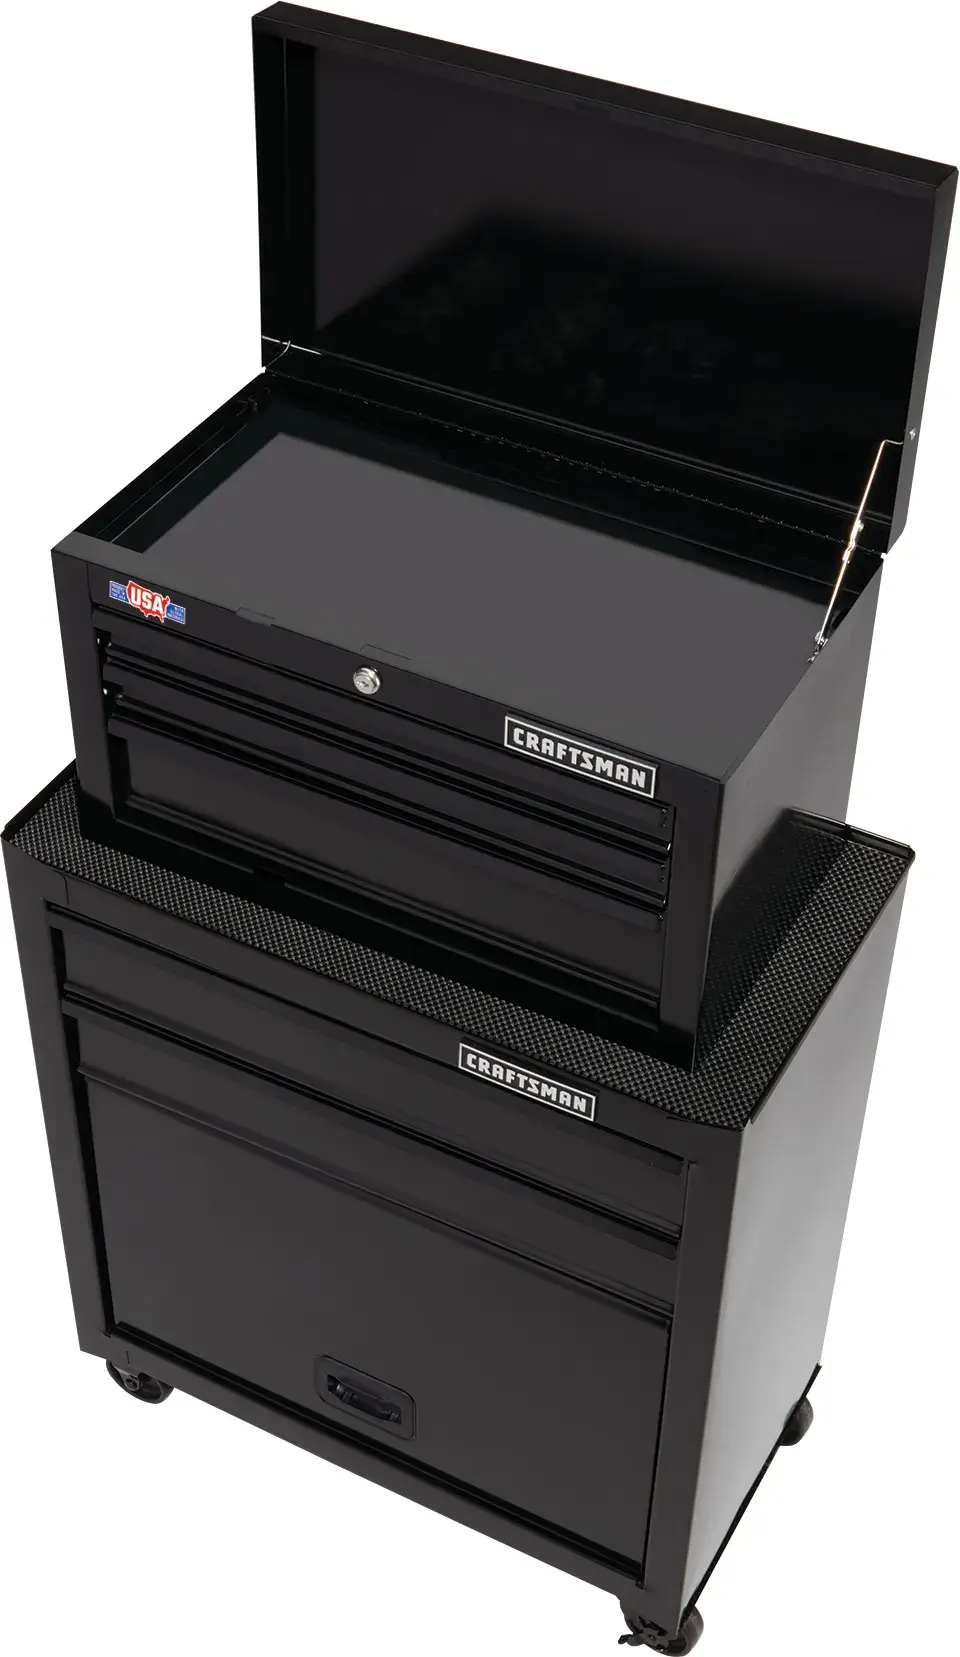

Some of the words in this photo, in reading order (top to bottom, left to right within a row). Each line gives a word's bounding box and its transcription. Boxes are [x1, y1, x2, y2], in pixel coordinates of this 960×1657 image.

[131, 586, 163, 615] USA
[513, 727, 646, 788] CRAFTSMAN
[466, 1053, 587, 1113] CRAFTSMAN
